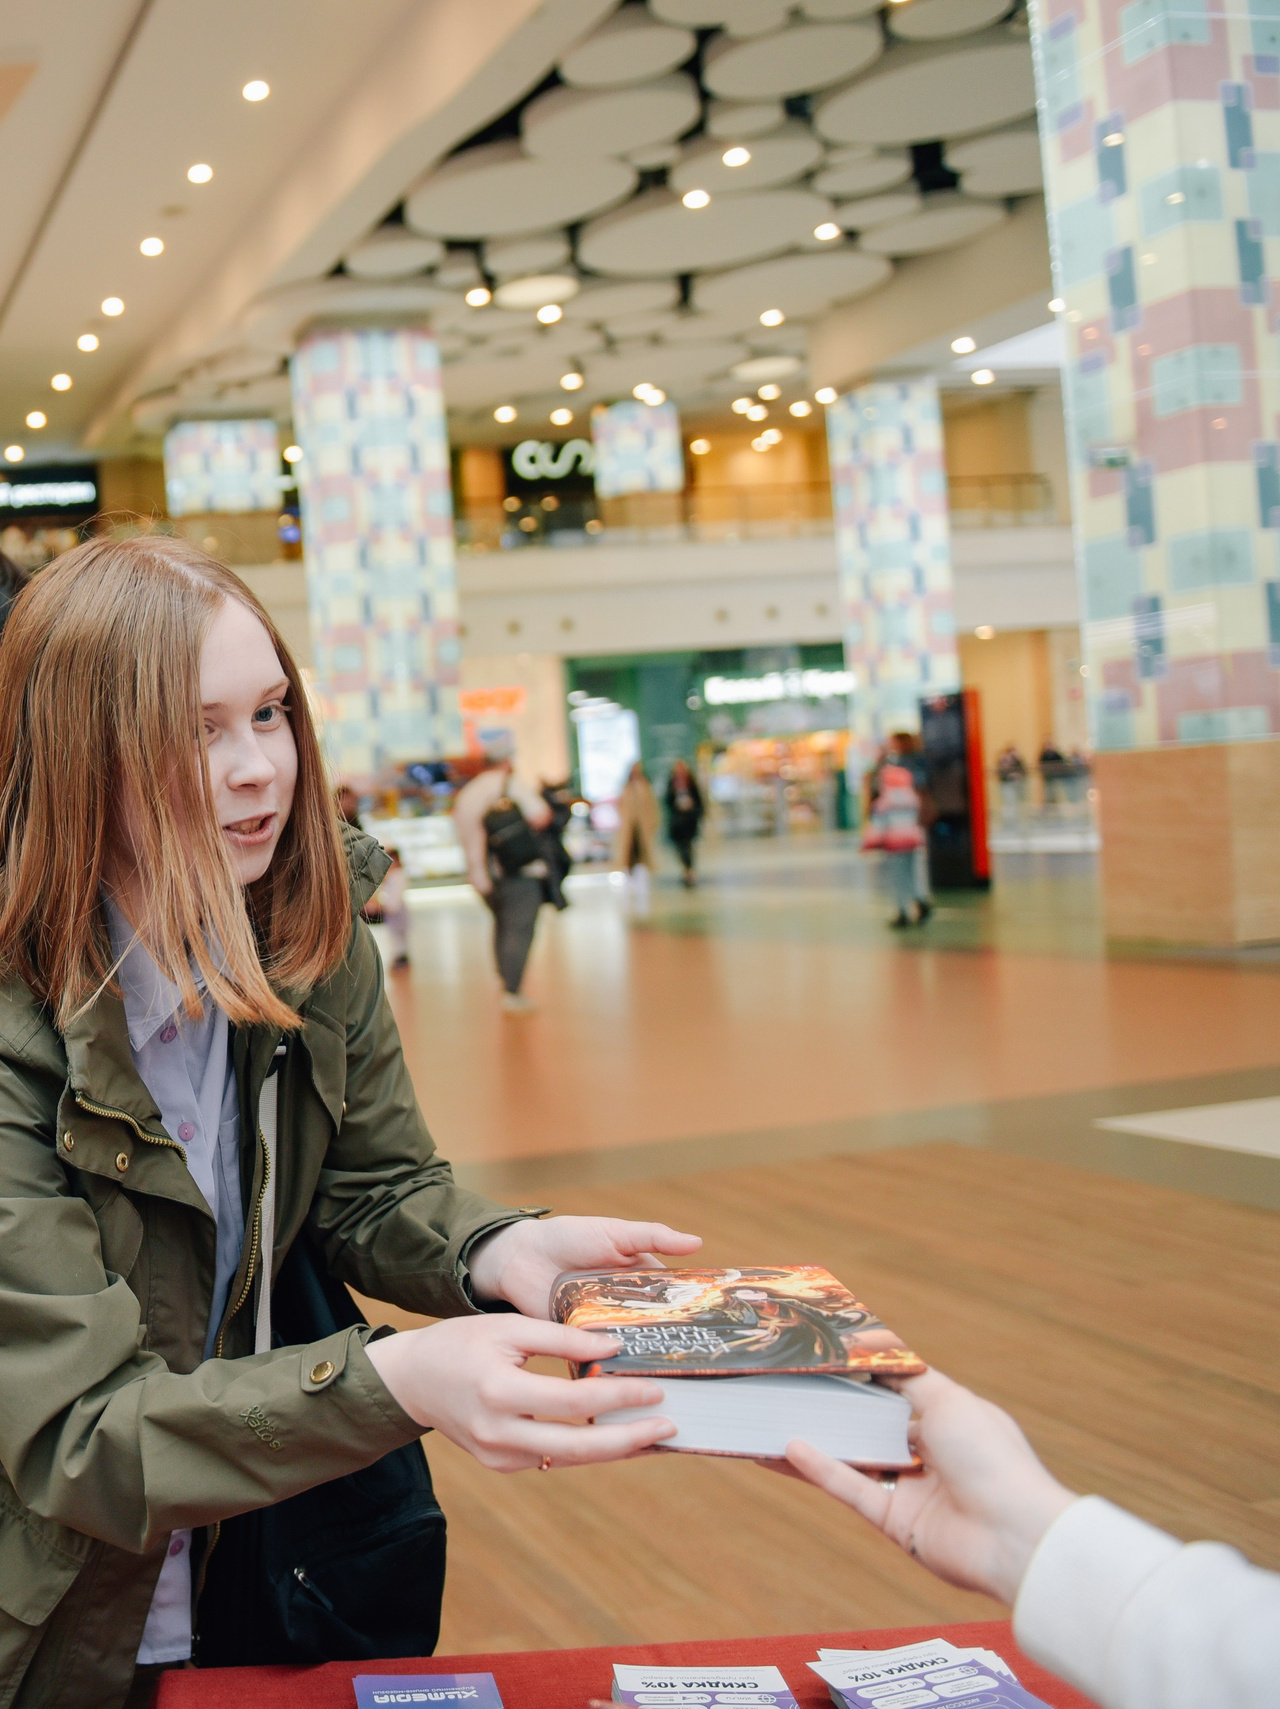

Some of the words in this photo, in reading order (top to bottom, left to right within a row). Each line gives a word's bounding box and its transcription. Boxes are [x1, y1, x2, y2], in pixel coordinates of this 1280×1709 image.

[635, 1331, 721, 1341] ОГНЕ
[881, 1656, 949, 1676] СКИДКА
[847, 1670, 882, 1682] 10%
[641, 1681, 678, 1689] 10%
[681, 1681, 759, 1689] СКИДКА
